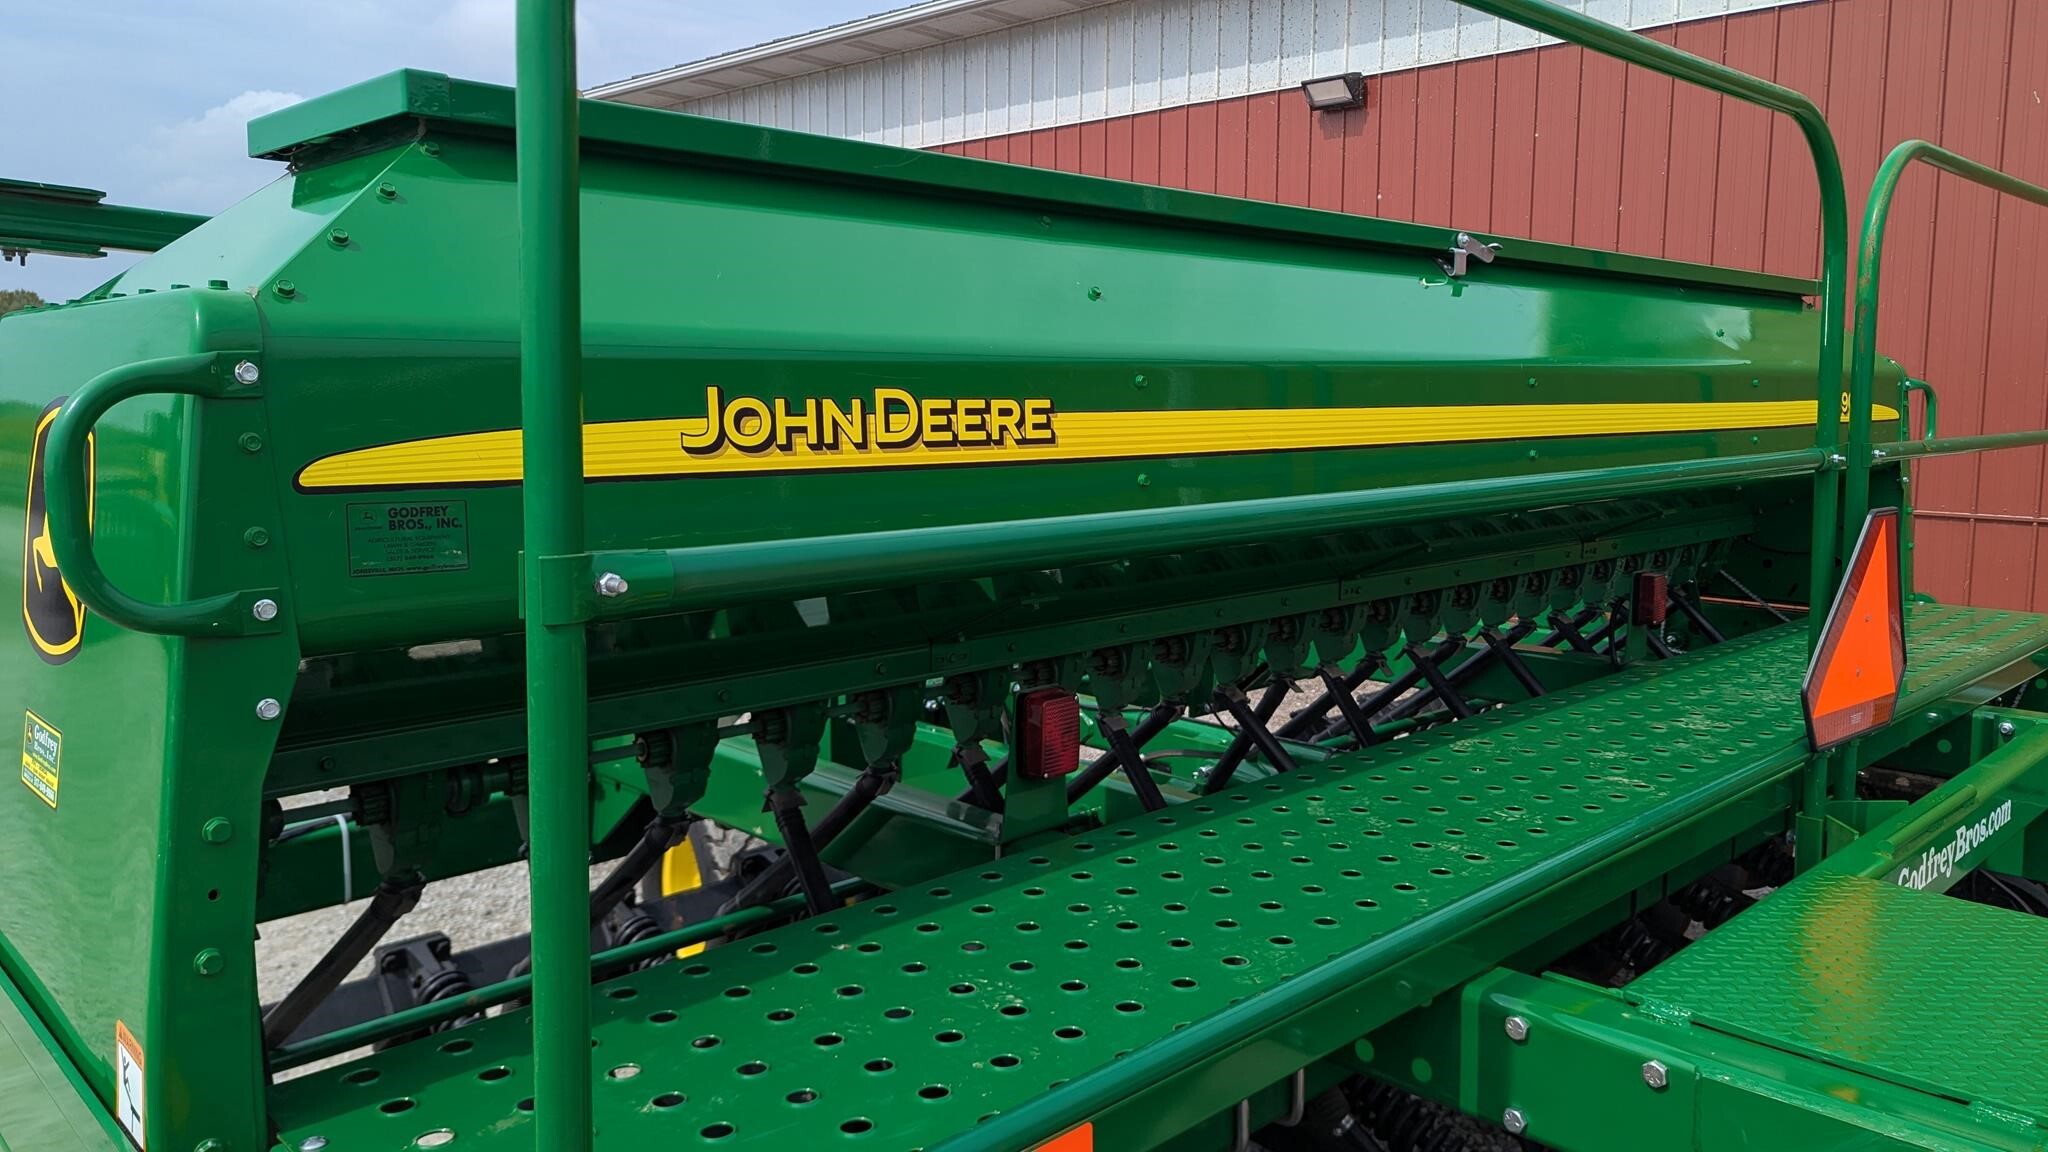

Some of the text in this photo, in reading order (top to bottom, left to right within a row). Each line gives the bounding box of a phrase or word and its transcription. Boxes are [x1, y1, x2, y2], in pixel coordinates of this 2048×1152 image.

[680, 384, 1057, 455] JOHN DEERE
[388, 506, 449, 519] GODFREY
[388, 519, 432, 531] BROS.,
[436, 517, 463, 529] INC.
[34, 724, 58, 756] Godfrey
[1897, 799, 2012, 890] GodfreyBros.com
